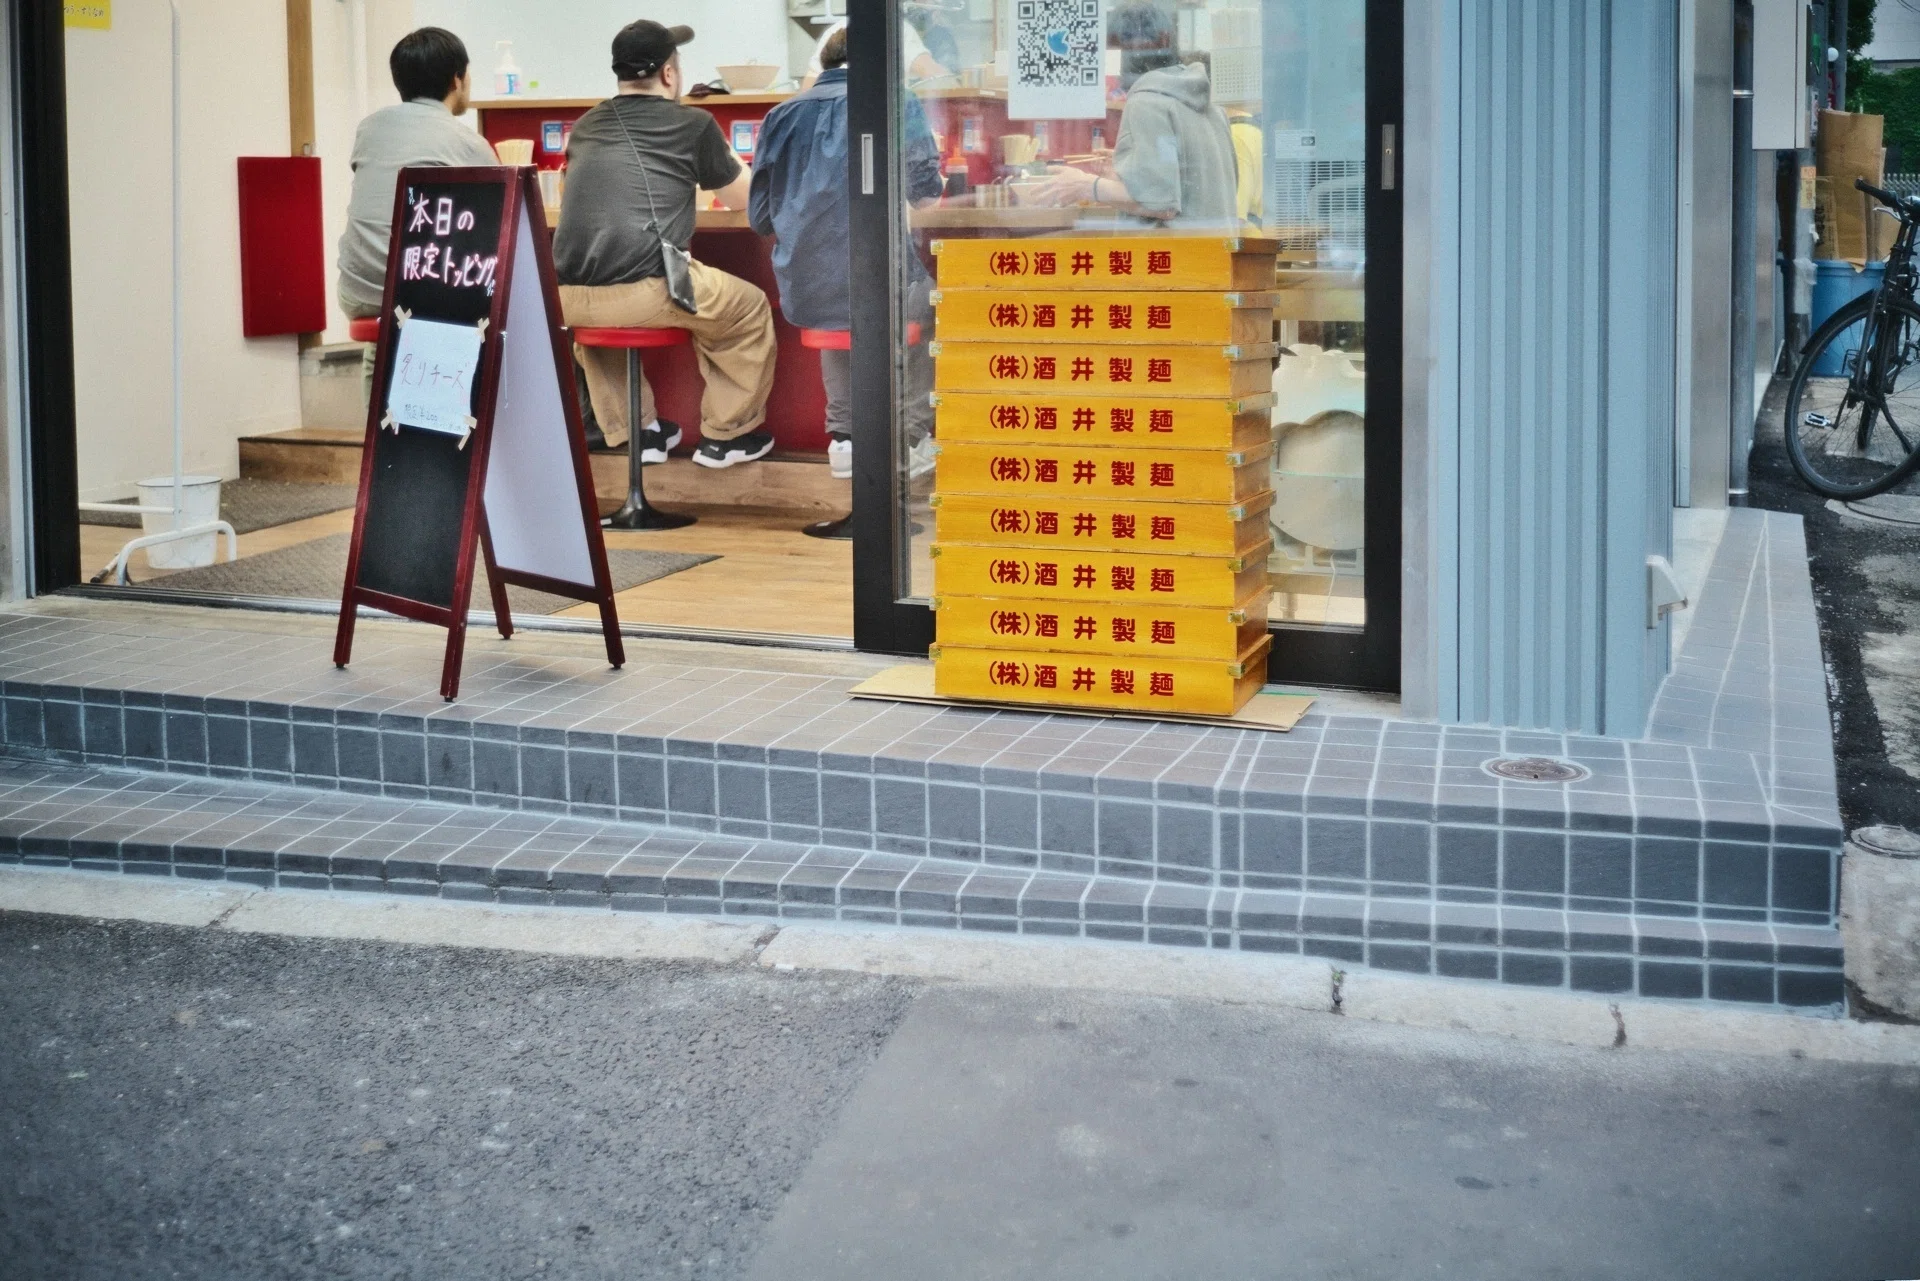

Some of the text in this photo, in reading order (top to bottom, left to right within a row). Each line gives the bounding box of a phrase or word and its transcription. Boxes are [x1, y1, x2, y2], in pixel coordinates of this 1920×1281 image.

[409, 193, 474, 235] 本日の
[403, 243, 498, 287] 限定トッピング
